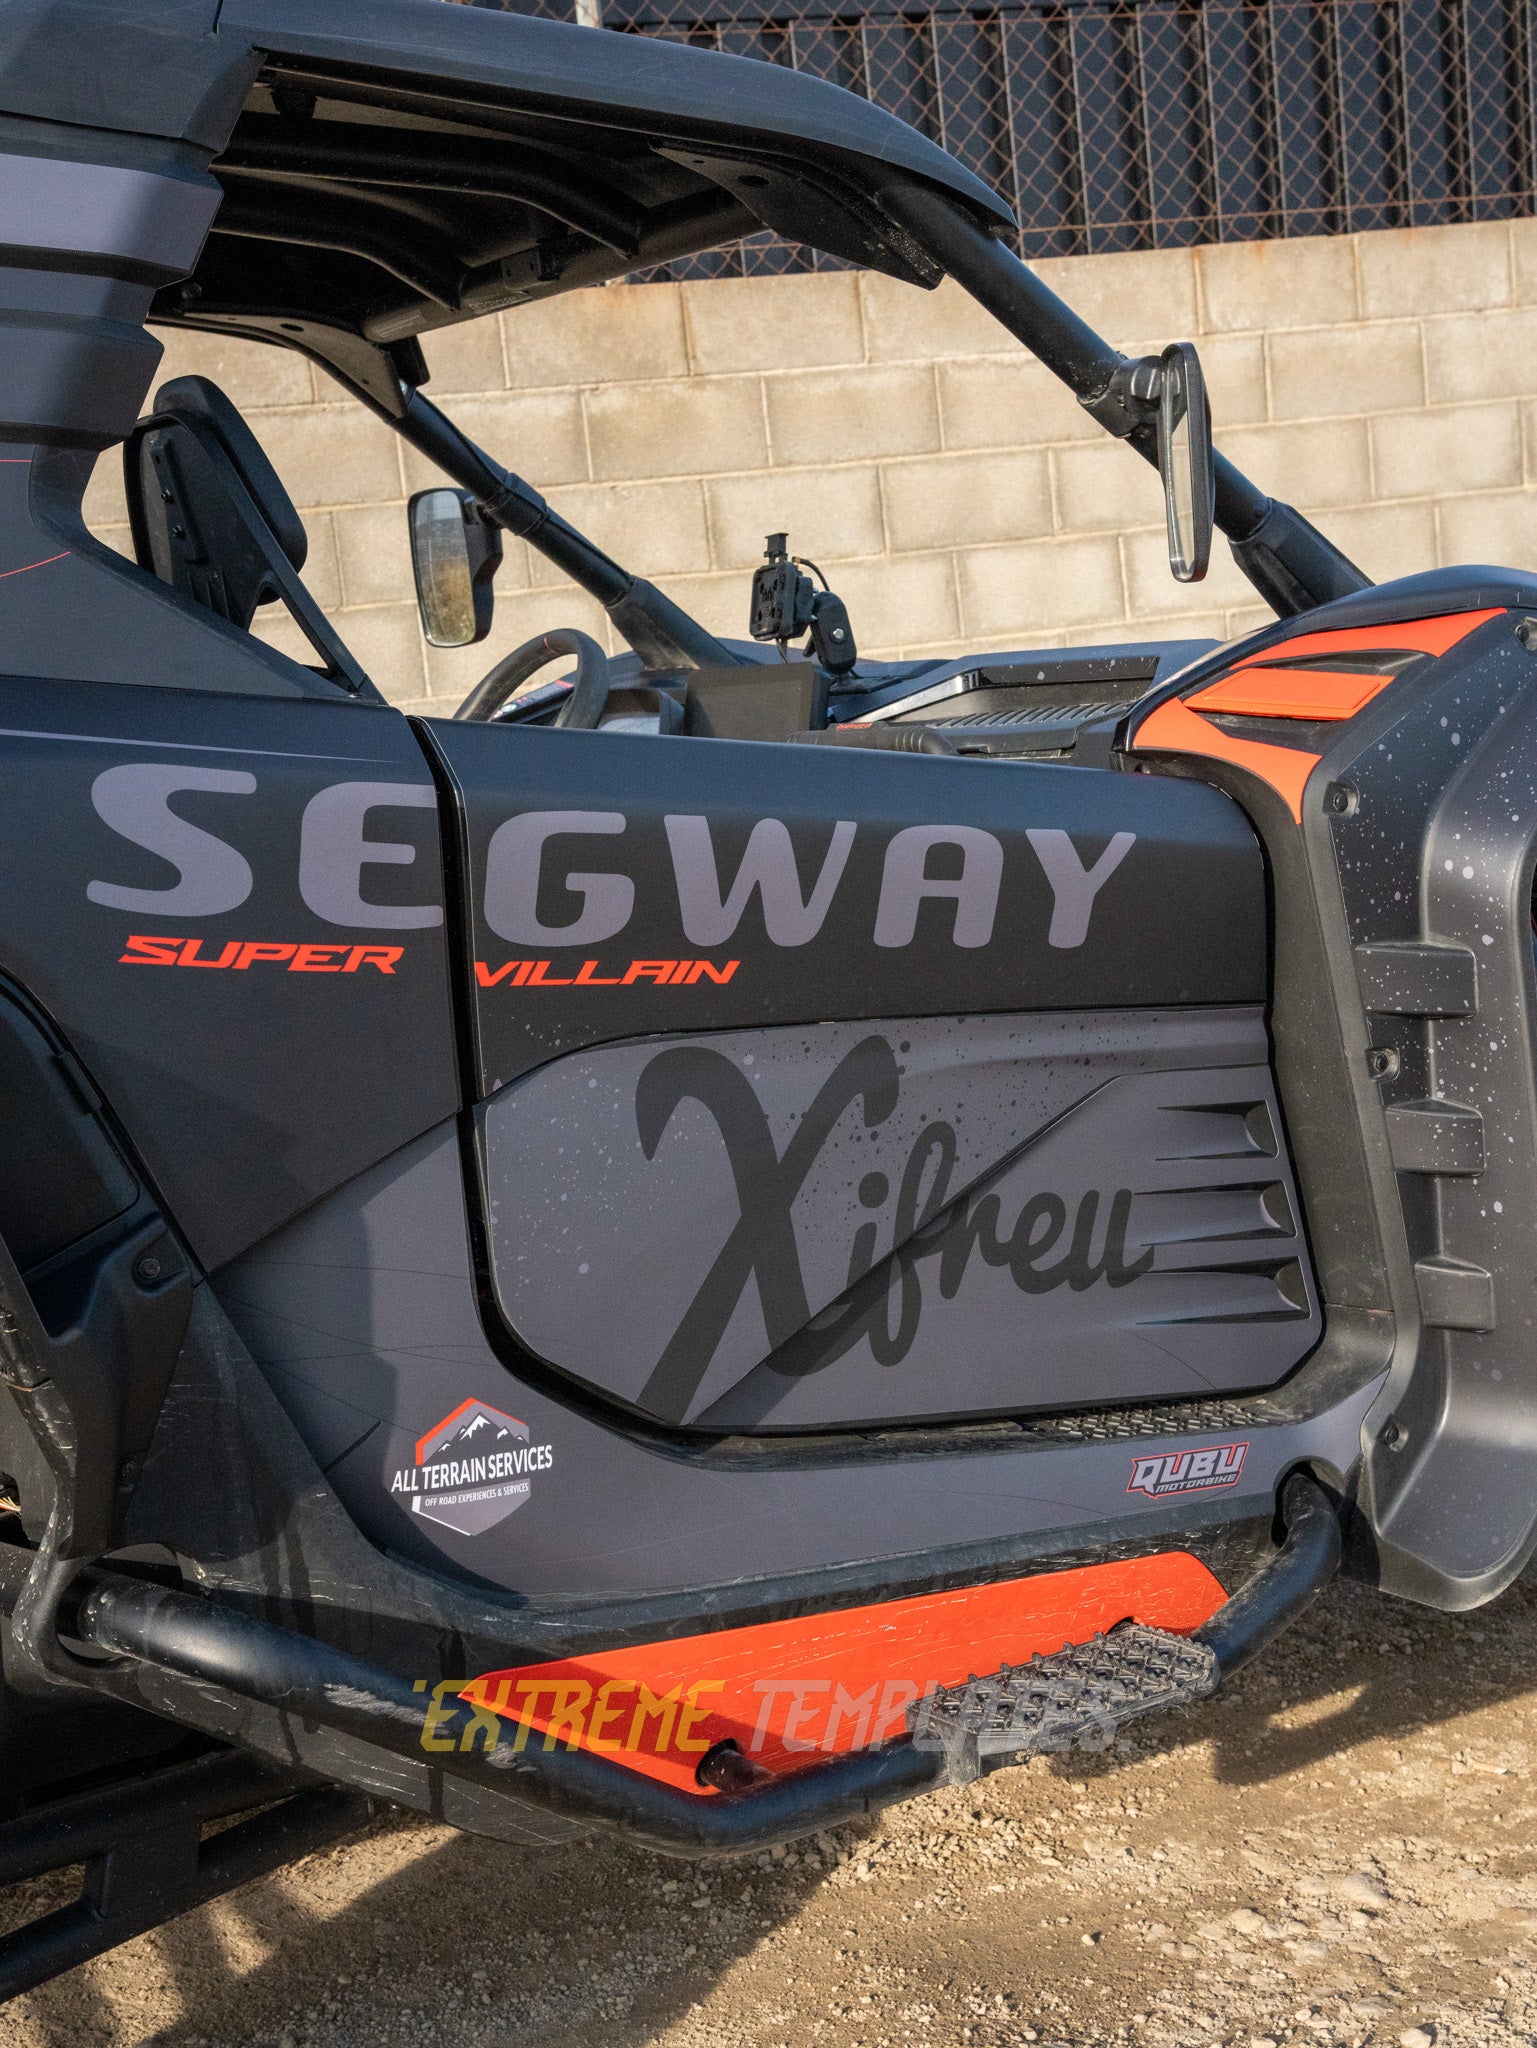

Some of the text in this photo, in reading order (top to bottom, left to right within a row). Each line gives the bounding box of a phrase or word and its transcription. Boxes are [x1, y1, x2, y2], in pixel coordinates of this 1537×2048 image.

[86, 762, 1137, 949] SEGWAY
[118, 935, 741, 988] SUPER VILLAIN
[391, 1444, 553, 1493] ALL TERRAIN SERVICES
[1131, 1445, 1247, 1495] QUBU
[1155, 1473, 1237, 1494] MOTORBIKE
[425, 1482, 529, 1507] OFF ROAD EXPERIENCES & SERVICES
